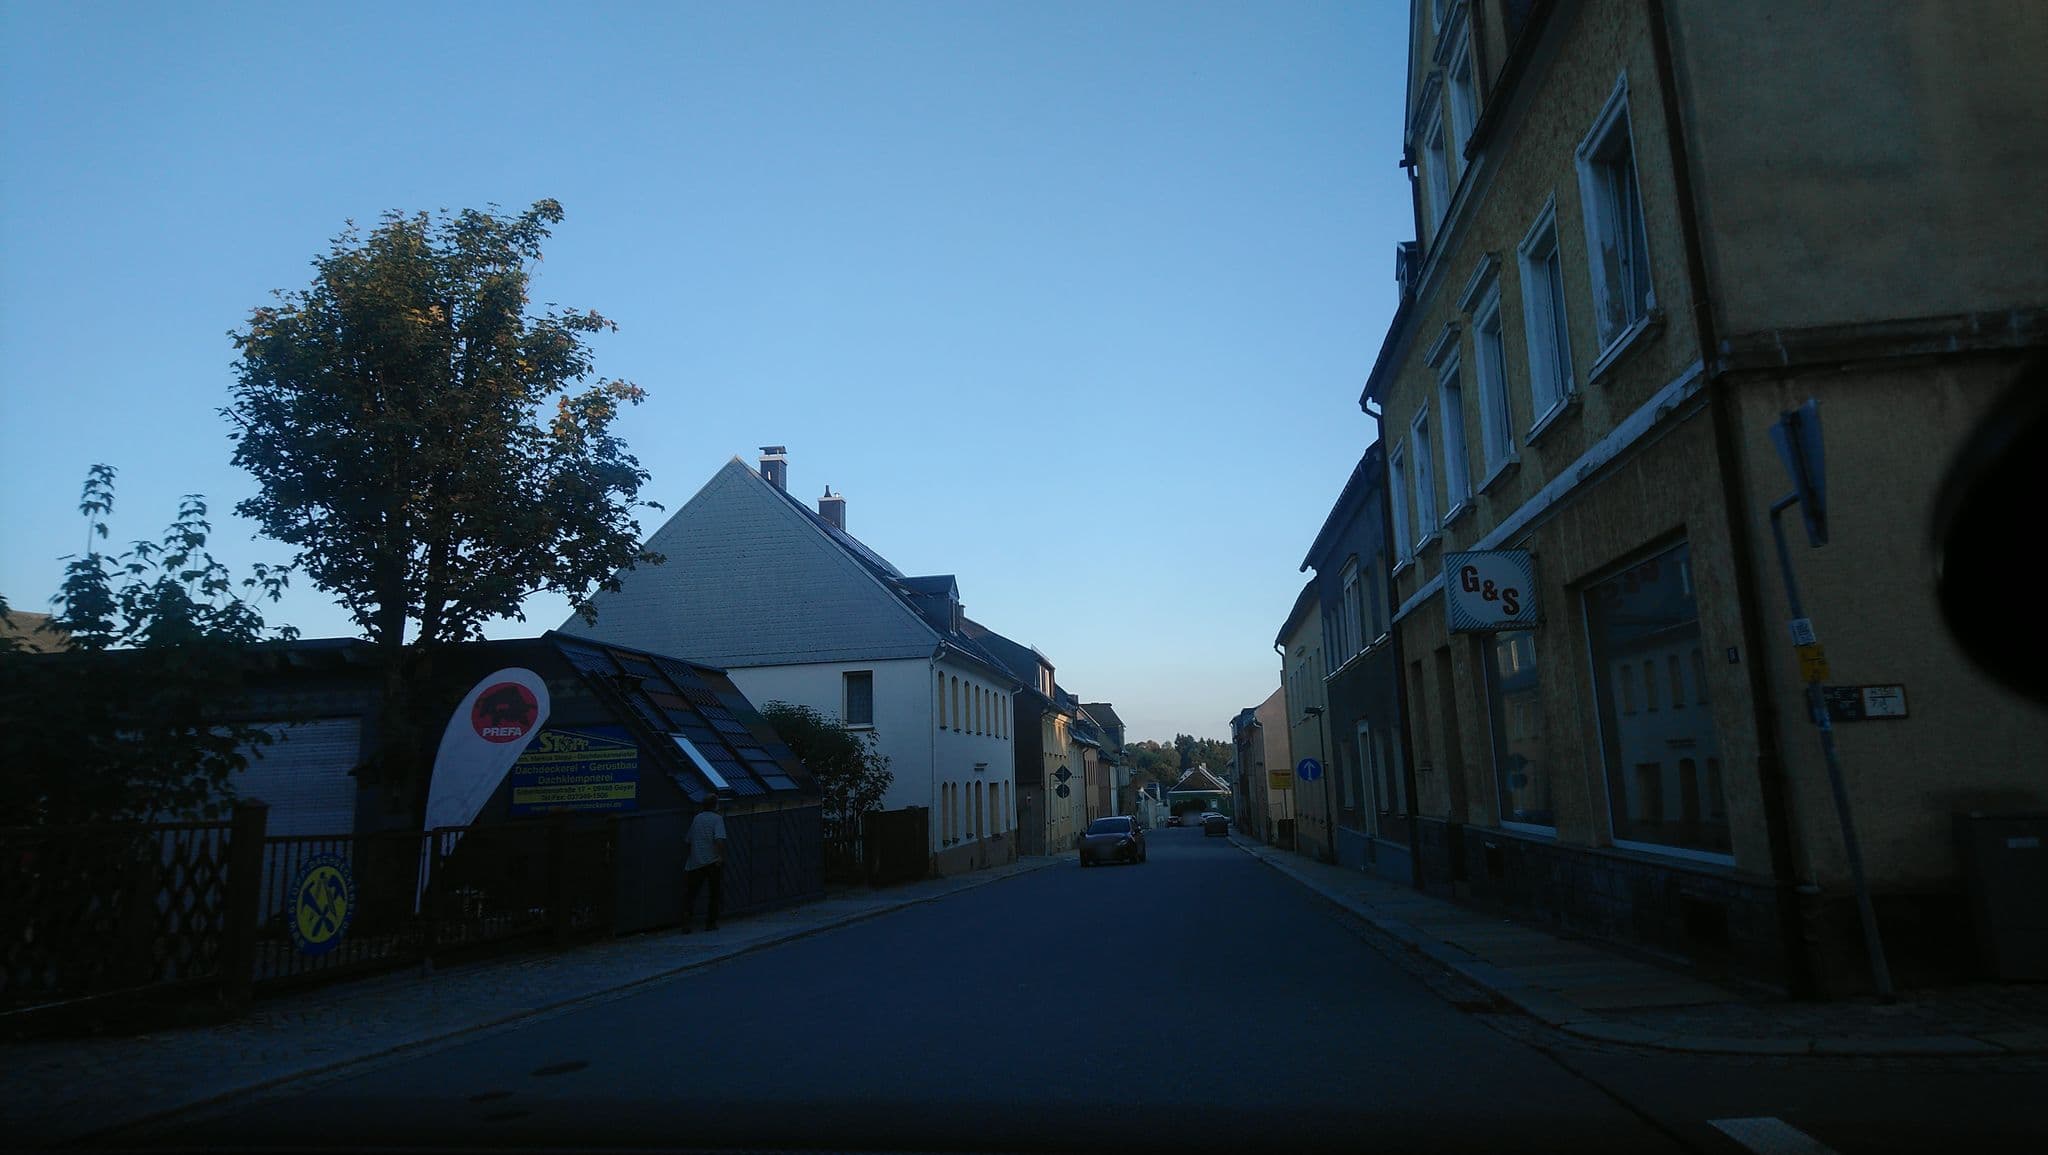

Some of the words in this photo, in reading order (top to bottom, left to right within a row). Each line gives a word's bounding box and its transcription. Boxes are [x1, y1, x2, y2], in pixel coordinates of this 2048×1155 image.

[1460, 565, 1520, 616] G&S
[482, 727, 522, 737] PREFA
[515, 763, 579, 775] Dachdeckerei
[538, 773, 614, 785] Dachklempnerei
